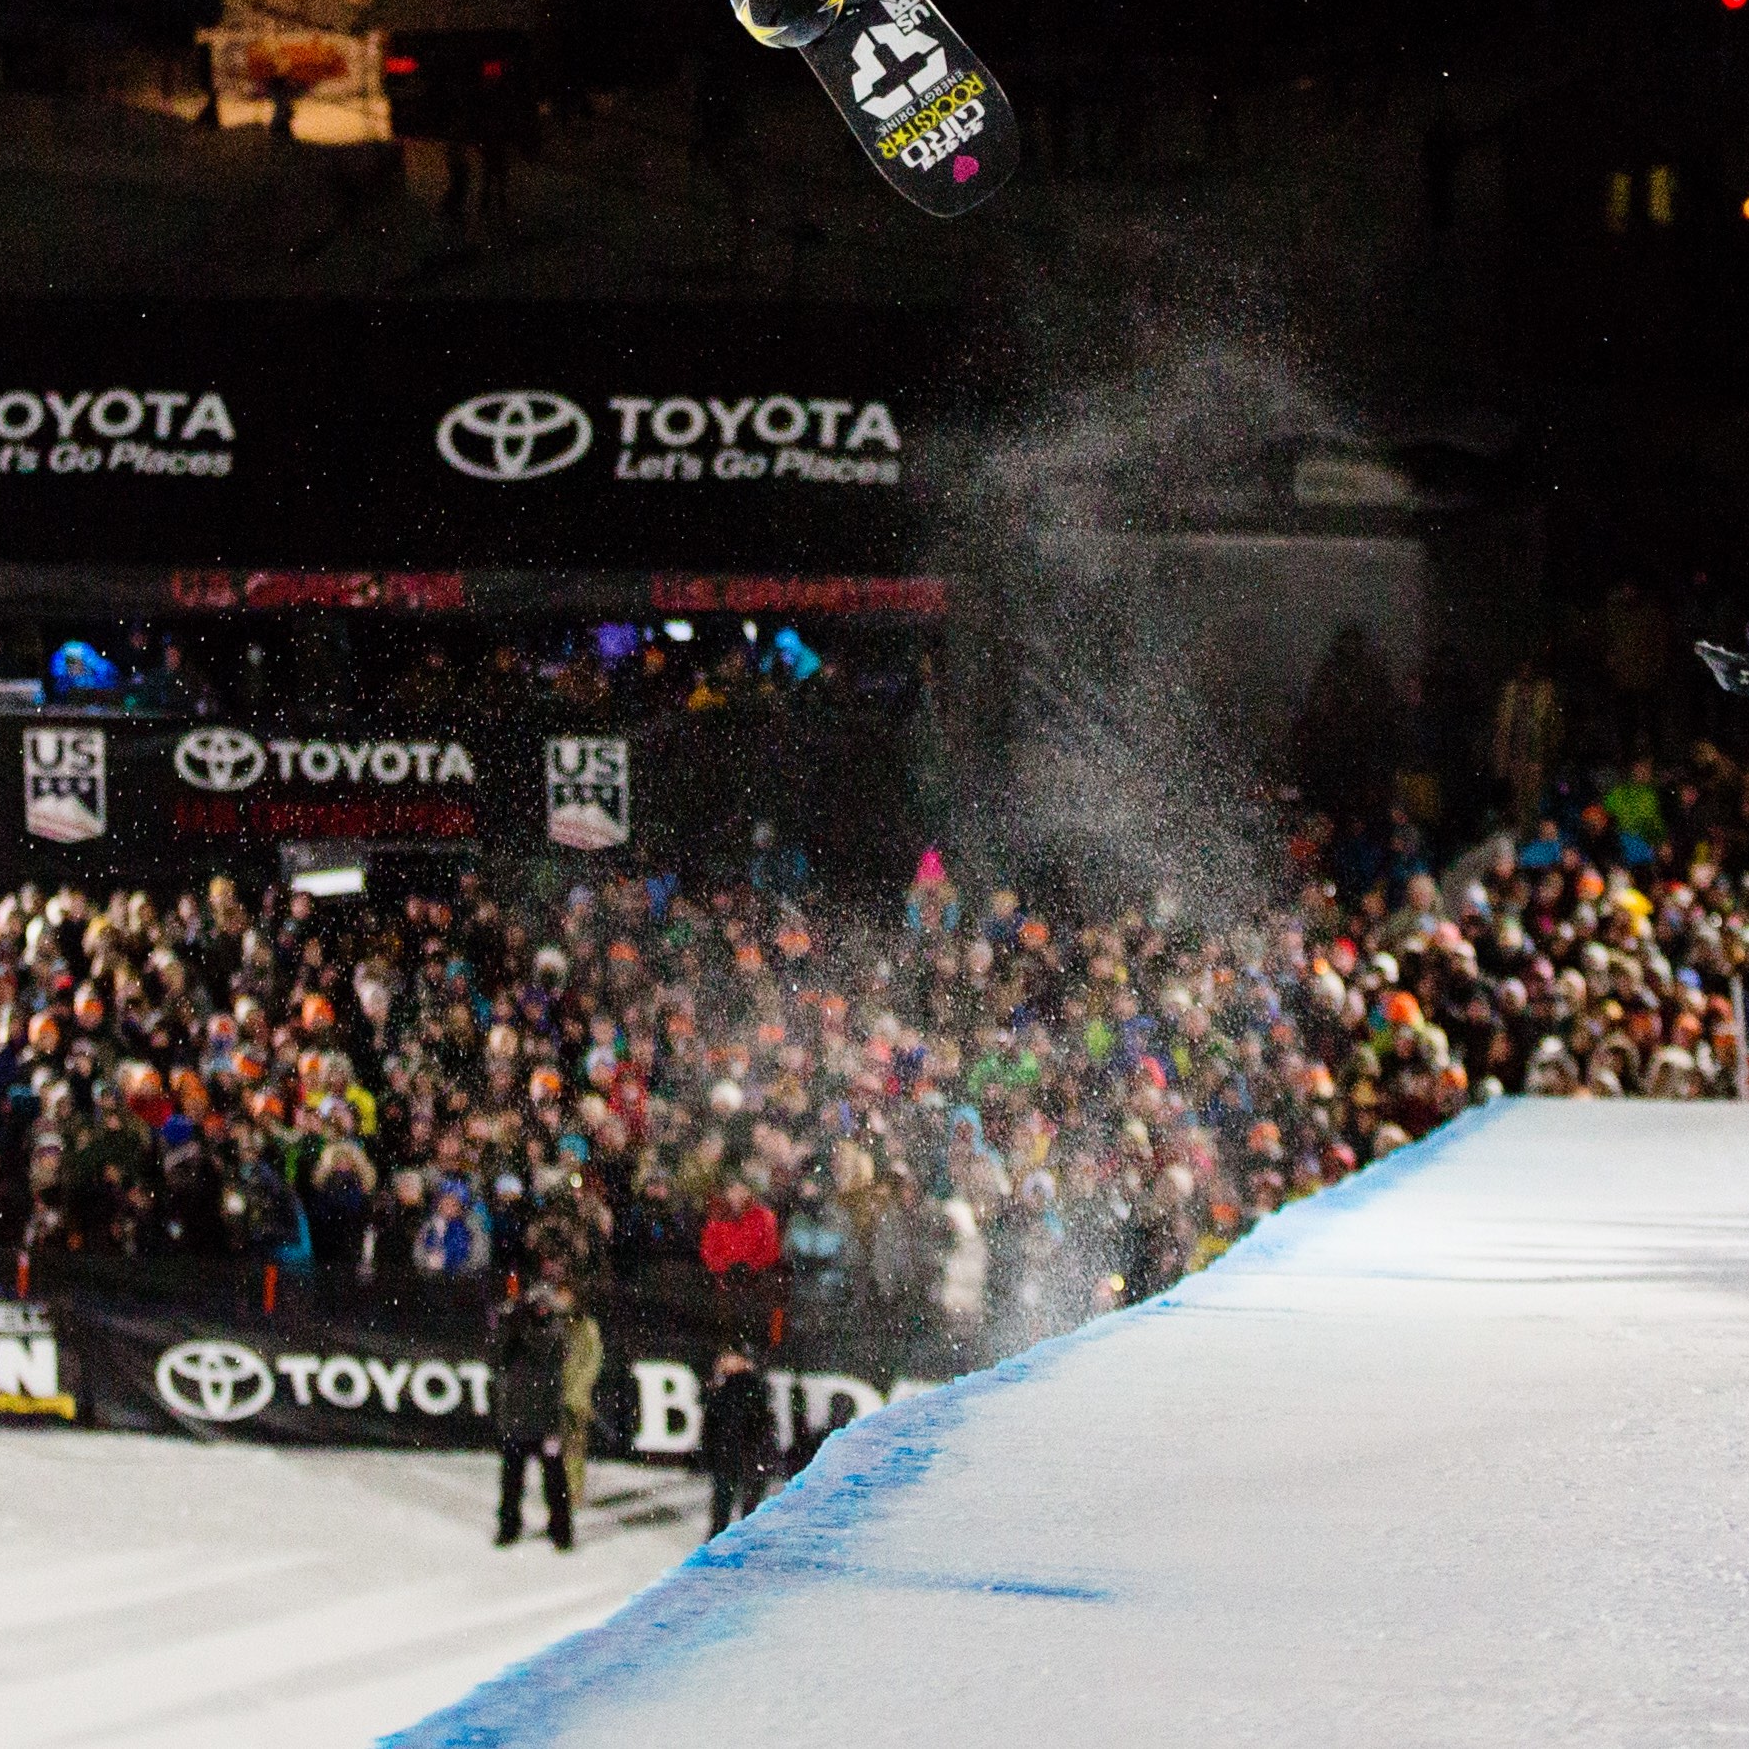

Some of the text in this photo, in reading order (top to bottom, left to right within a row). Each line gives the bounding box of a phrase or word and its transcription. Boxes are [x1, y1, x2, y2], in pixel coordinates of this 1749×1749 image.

[917, 68, 965, 109] ENERGY
[608, 394, 902, 451] TOYOTA
[50, 442, 102, 472] Go
[108, 442, 234, 477] Places
[269, 740, 478, 785] TOYOTA
[277, 1352, 492, 1417] TOYOT
